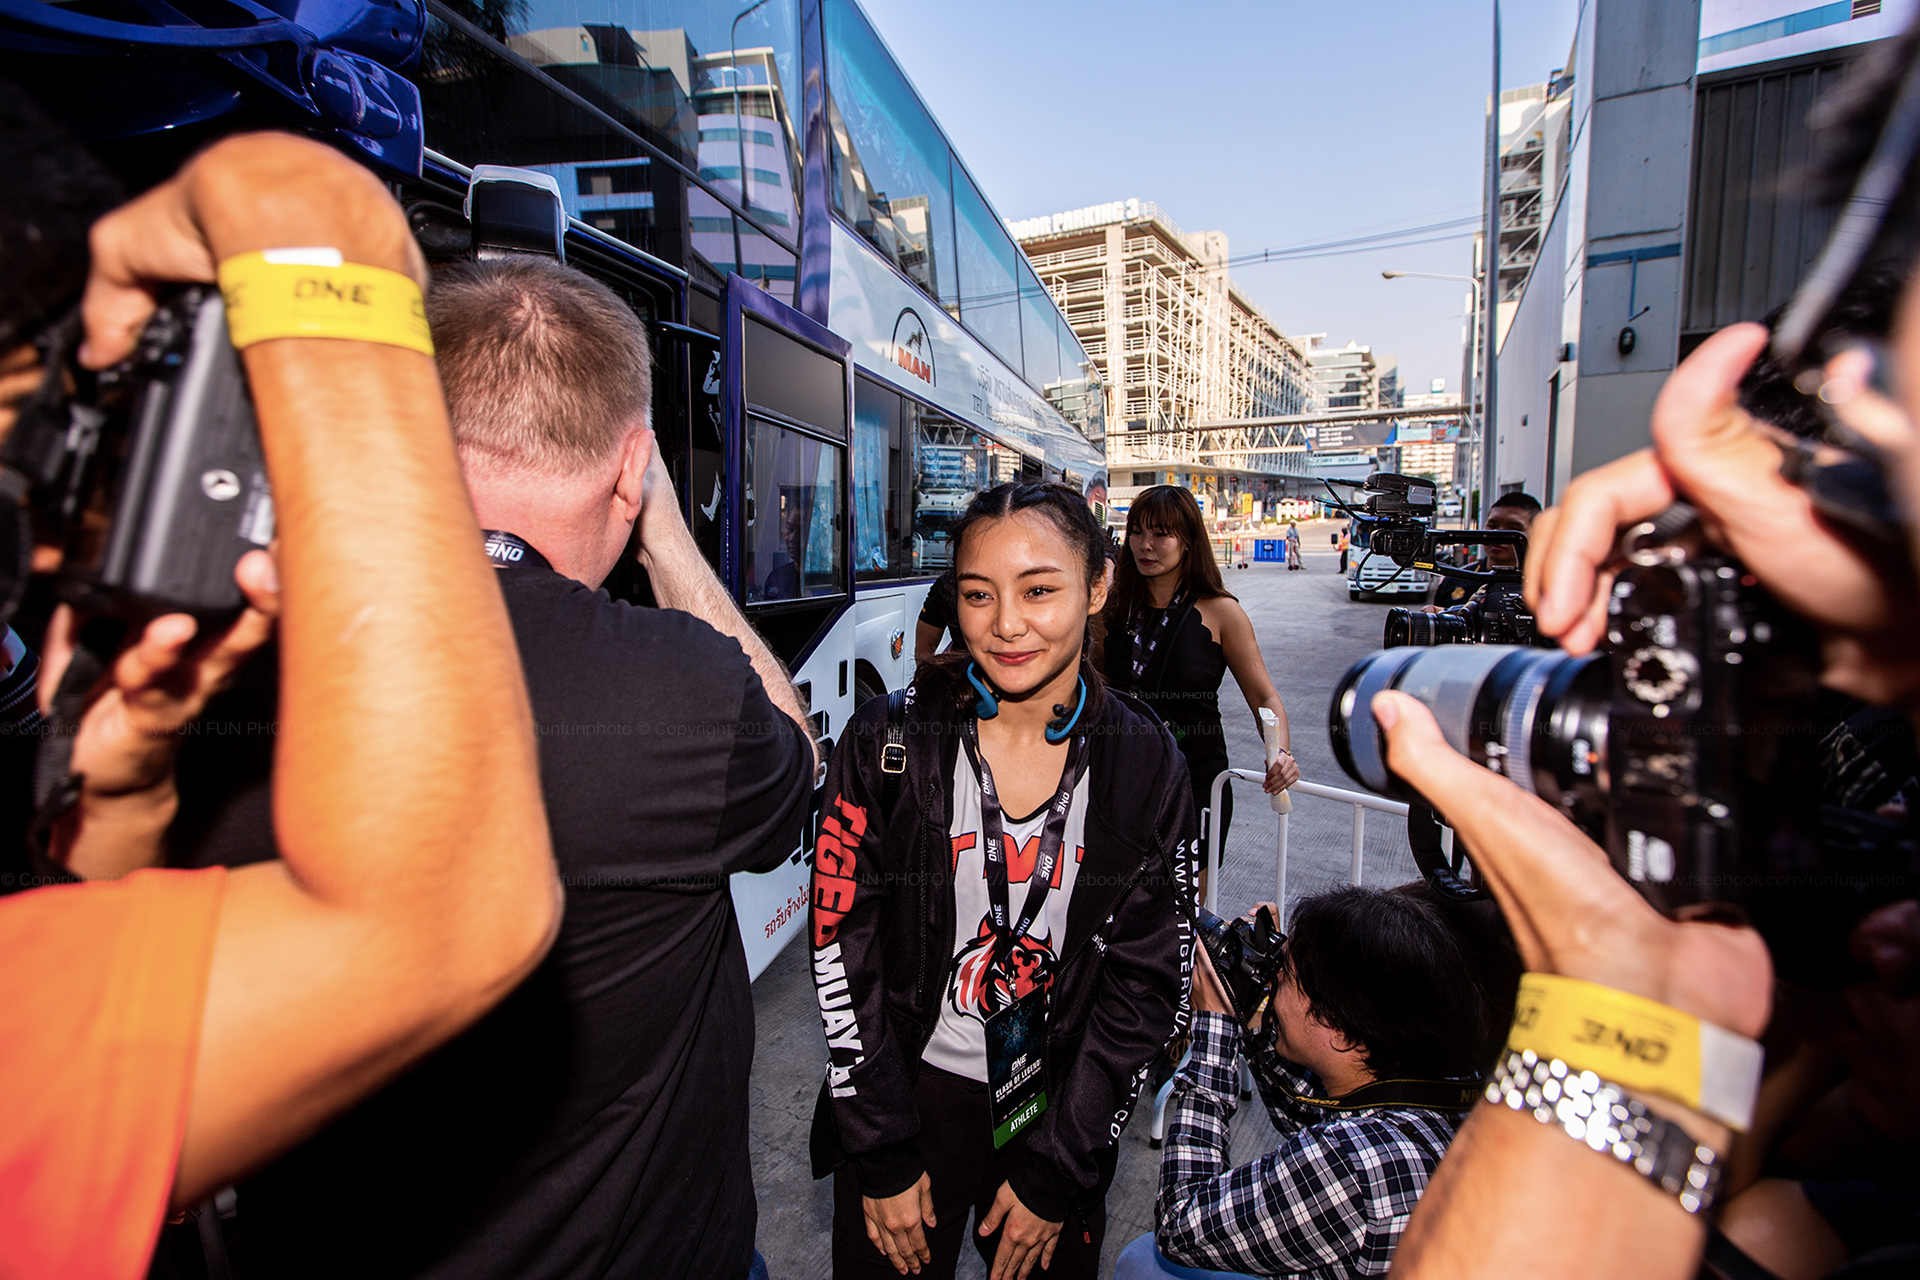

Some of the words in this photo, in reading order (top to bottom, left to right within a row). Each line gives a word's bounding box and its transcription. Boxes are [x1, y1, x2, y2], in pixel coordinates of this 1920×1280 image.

[1053, 200, 1125, 232] PARKING
[1126, 197, 1140, 219] 3
[294, 277, 373, 305] ONE
[898, 346, 931, 384] MAN
[484, 542, 525, 562] ONE
[1515, 613, 1534, 621] Canon
[1057, 791, 1070, 815] ONE
[987, 837, 996, 862] ONE
[1041, 854, 1054, 881] ONE
[995, 904, 1004, 927] ONE
[1017, 917, 1030, 938] ONE
[814, 942, 863, 1051] MUAY
[1011, 1053, 1027, 1071] ONE
[995, 1080, 1013, 1099] CLASH
[1013, 1074, 1021, 1085] OF
[1010, 1102, 1039, 1133] ATHLETE
